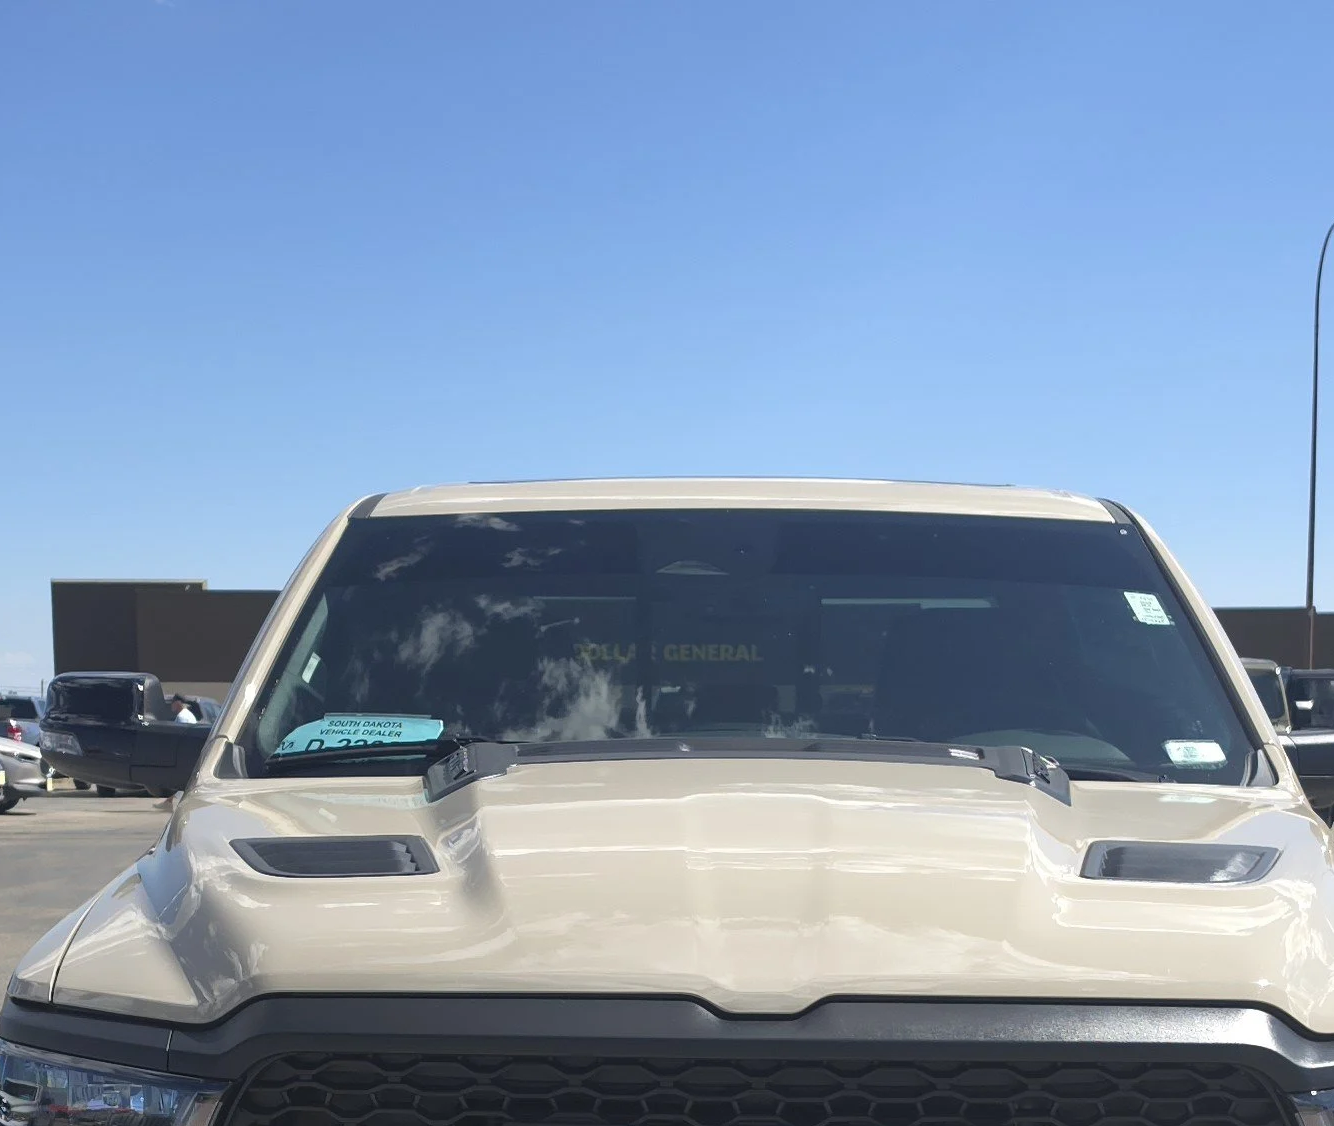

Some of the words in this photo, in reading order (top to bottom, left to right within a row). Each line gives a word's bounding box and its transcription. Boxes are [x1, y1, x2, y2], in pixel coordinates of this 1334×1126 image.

[663, 643, 764, 662] GENERAL
[327, 720, 360, 728] SOUTH
[363, 721, 403, 729] DAKOTA
[362, 730, 402, 738] DEALER
